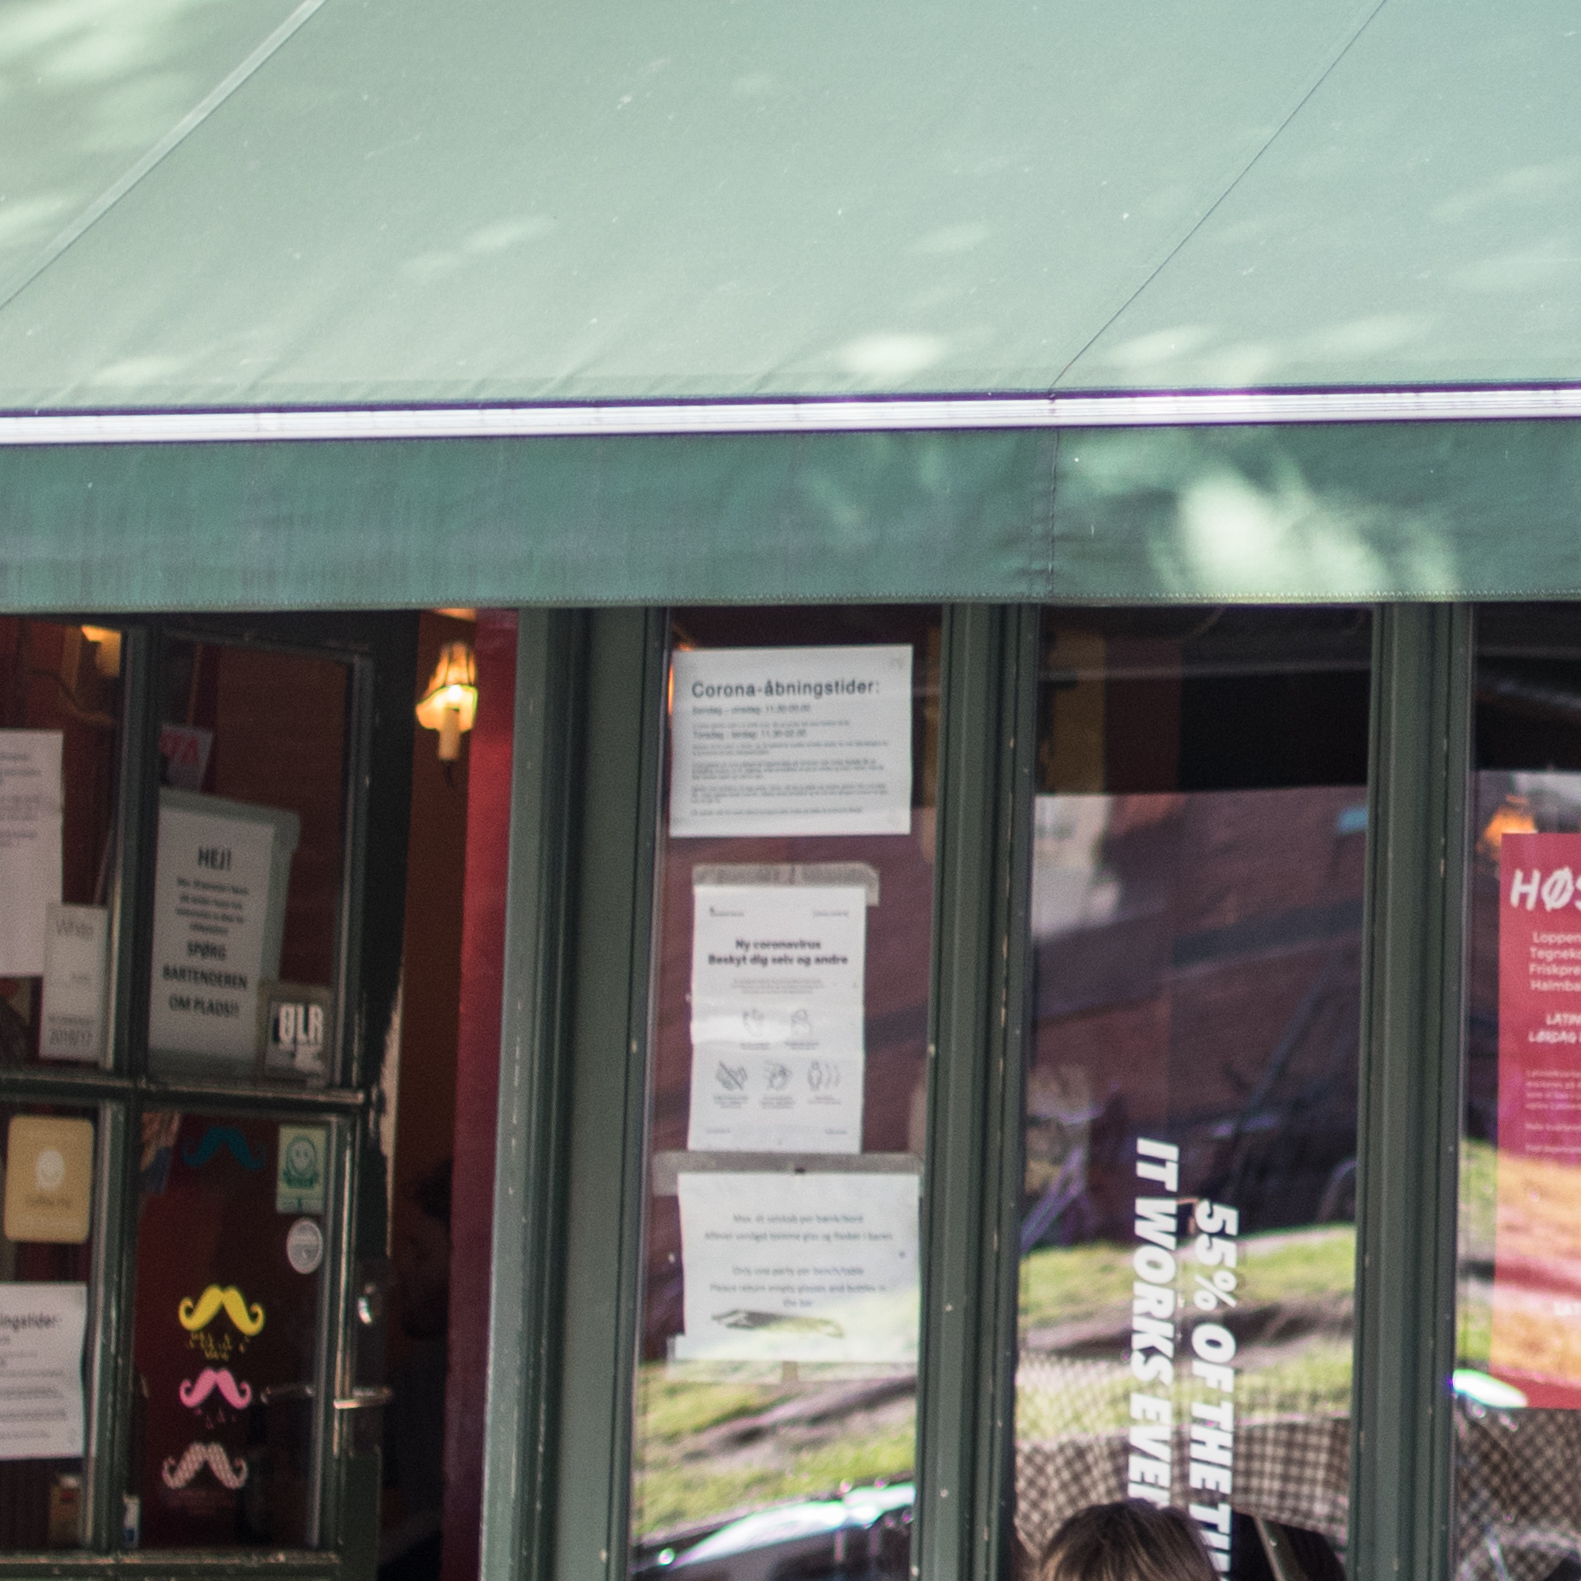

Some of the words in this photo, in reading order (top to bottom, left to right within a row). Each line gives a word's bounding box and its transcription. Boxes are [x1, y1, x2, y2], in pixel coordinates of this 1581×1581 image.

[691, 677, 880, 700] Corona-åbningstider:
[198, 847, 232, 871] HEJ!
[162, 964, 248, 992] BARTENDEREN
[1135, 1137, 1180, 1192] IT
[1194, 1199, 1239, 1311] 55%
[1130, 1197, 1178, 1386] WORKS
[1190, 1322, 1237, 1394] OF
[1188, 1401, 1235, 1496] THE
